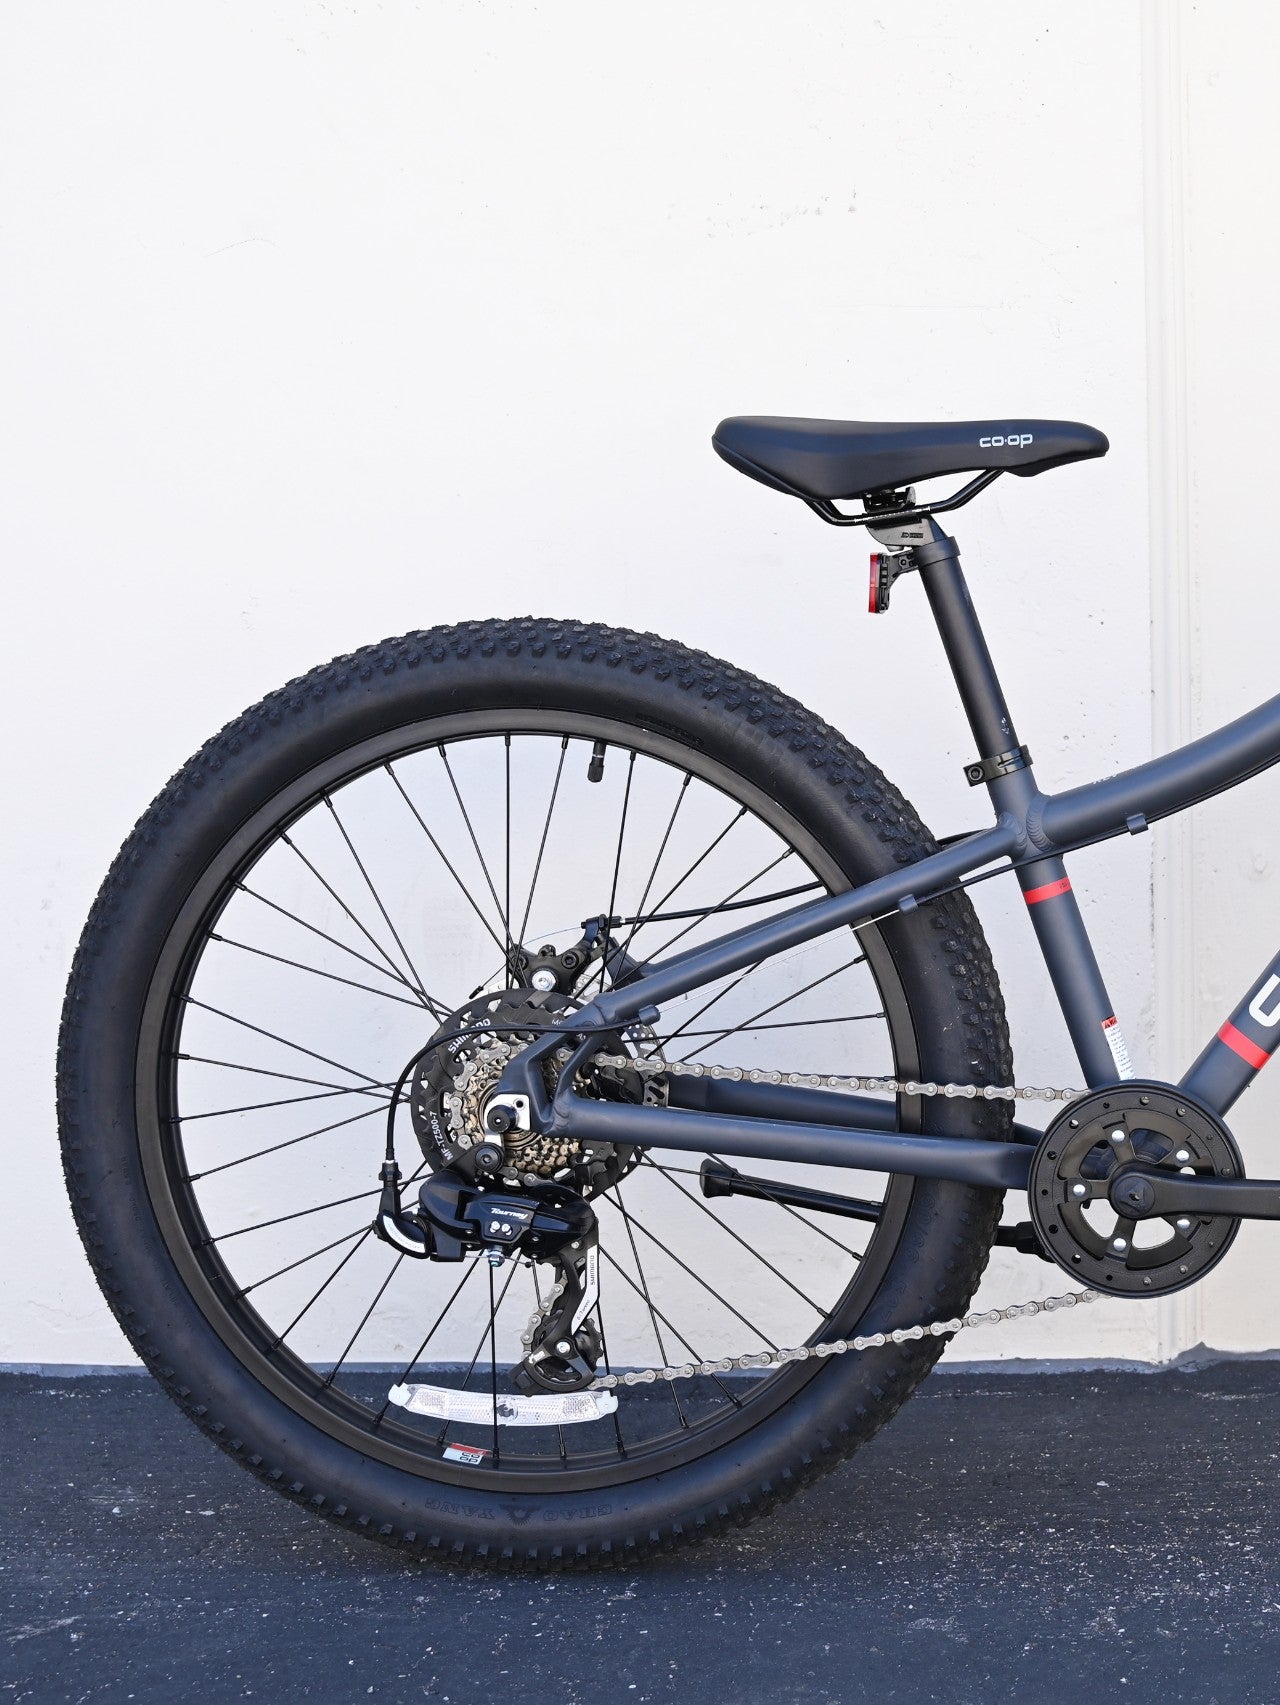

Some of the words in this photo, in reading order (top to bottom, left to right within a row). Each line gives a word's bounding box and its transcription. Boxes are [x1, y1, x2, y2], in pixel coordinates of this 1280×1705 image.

[448, 1018, 491, 1053] SHINO
[430, 1110, 453, 1160] MF-TZ500-7
[490, 1207, 528, 1219] Tourney
